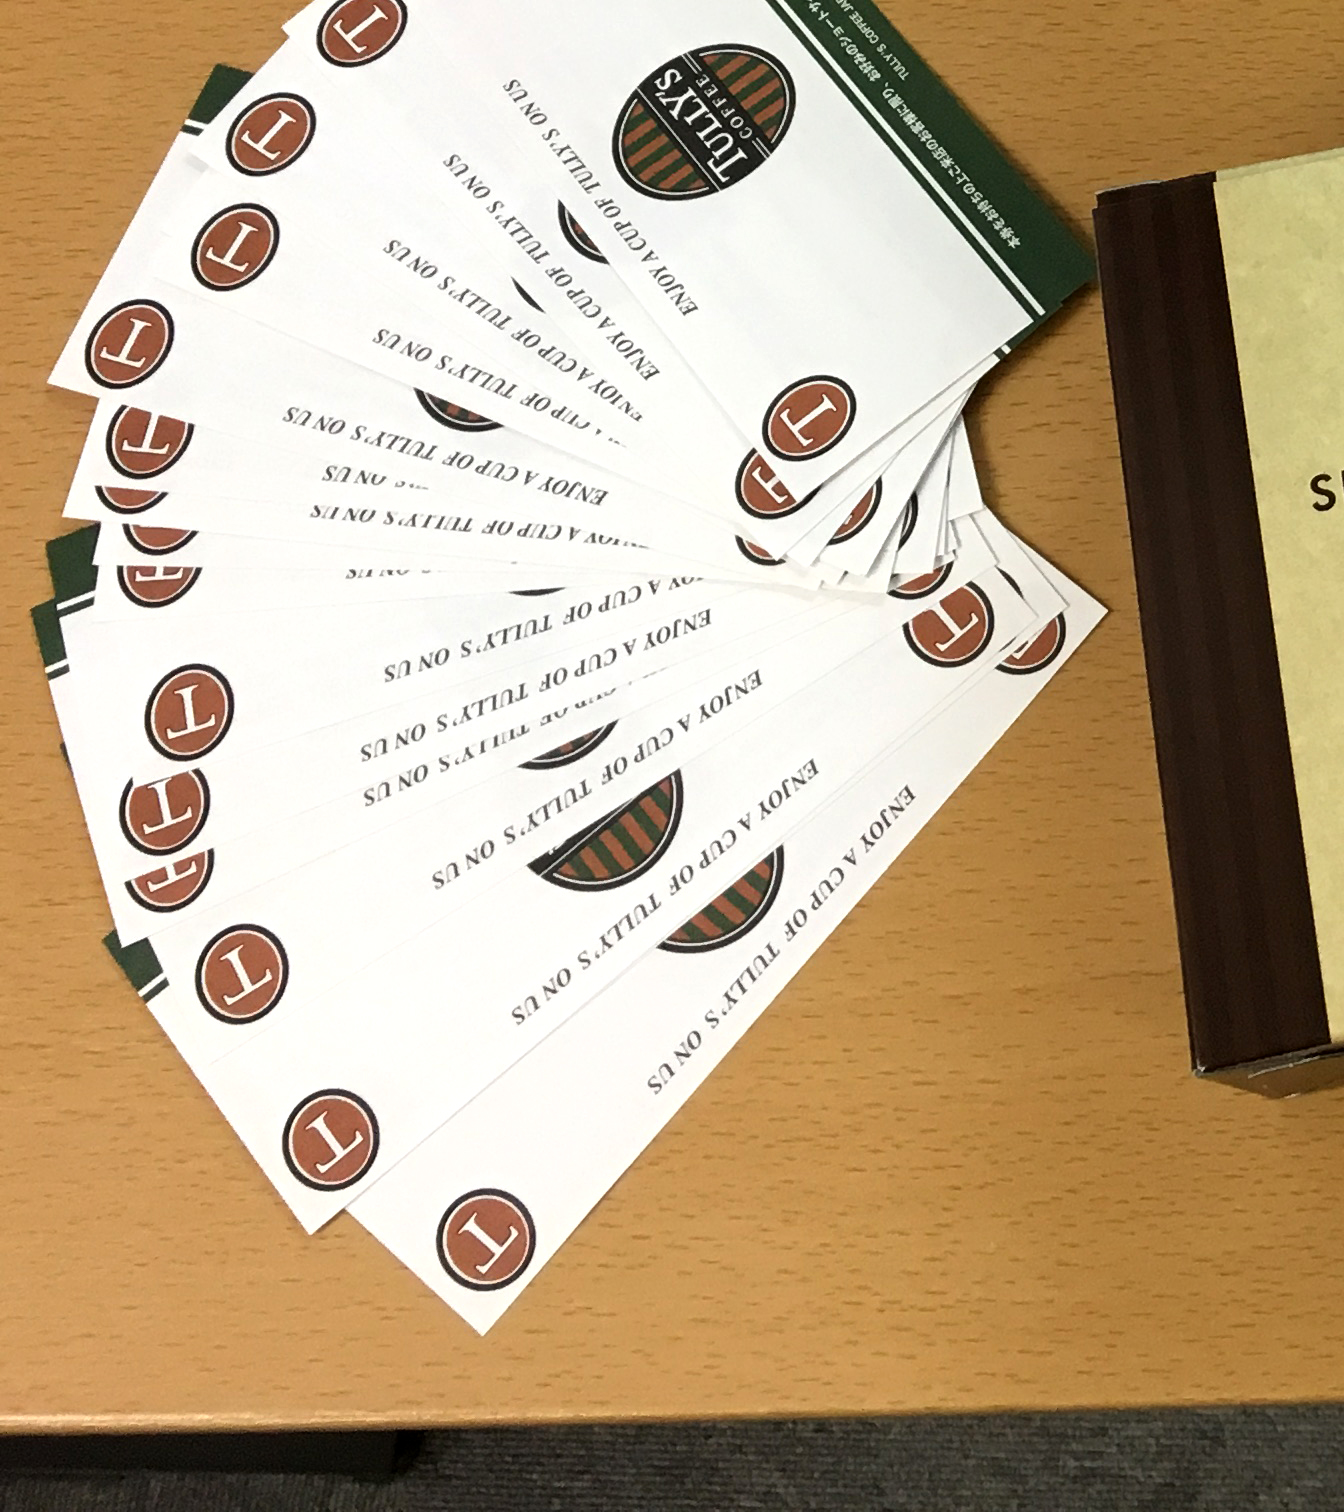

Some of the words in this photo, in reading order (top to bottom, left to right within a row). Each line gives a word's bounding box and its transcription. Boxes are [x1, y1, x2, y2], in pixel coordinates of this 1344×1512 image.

[334, 4, 388, 53] T
[849, 11, 879, 44] COFFEE
[877, 44, 909, 80] TULLY'S
[503, 80, 528, 103] US
[698, 73, 753, 142] COFFEE
[520, 102, 547, 125] ON
[654, 68, 747, 184] TULLY'S
[242, 110, 297, 160] T
[542, 129, 600, 194] TULLY'S
[594, 199, 621, 218] OF
[206, 221, 259, 272] T
[614, 222, 646, 250] CUP
[642, 250, 658, 261] A
[649, 266, 698, 316] ENJOY
[101, 318, 152, 368] T
[283, 407, 311, 426] US
[312, 416, 345, 434] ON
[780, 395, 837, 446] T
[350, 426, 437, 460] TULLY'S
[442, 452, 474, 469] OF
[475, 460, 519, 481] CUP
[524, 471, 539, 485] A
[538, 477, 608, 505] ENJOY
[644, 609, 711, 650] ENJOY
[574, 648, 617, 677] CUP
[623, 639, 636, 655] A
[539, 668, 567, 692] OF
[700, 670, 762, 723] ENJOY
[166, 685, 216, 739] T
[437, 683, 528, 732] TULLY'S
[677, 714, 689, 732] A
[361, 739, 387, 761] US
[396, 724, 426, 749] ON
[634, 728, 673, 762] CUP
[602, 757, 627, 785] OF
[142, 777, 192, 836] T
[504, 780, 592, 844] TULLY'S
[860, 785, 916, 853] ENJOY
[466, 840, 494, 869] ON
[843, 848, 856, 865] A
[433, 863, 460, 889] US
[811, 868, 844, 910] CUP
[785, 909, 807, 941] OF
[221, 945, 272, 1005] T
[705, 943, 780, 1029] TULLY'S
[674, 1031, 701, 1065] ON
[648, 1064, 675, 1094] US
[305, 1112, 363, 1174] T
[458, 1212, 519, 1275] T
